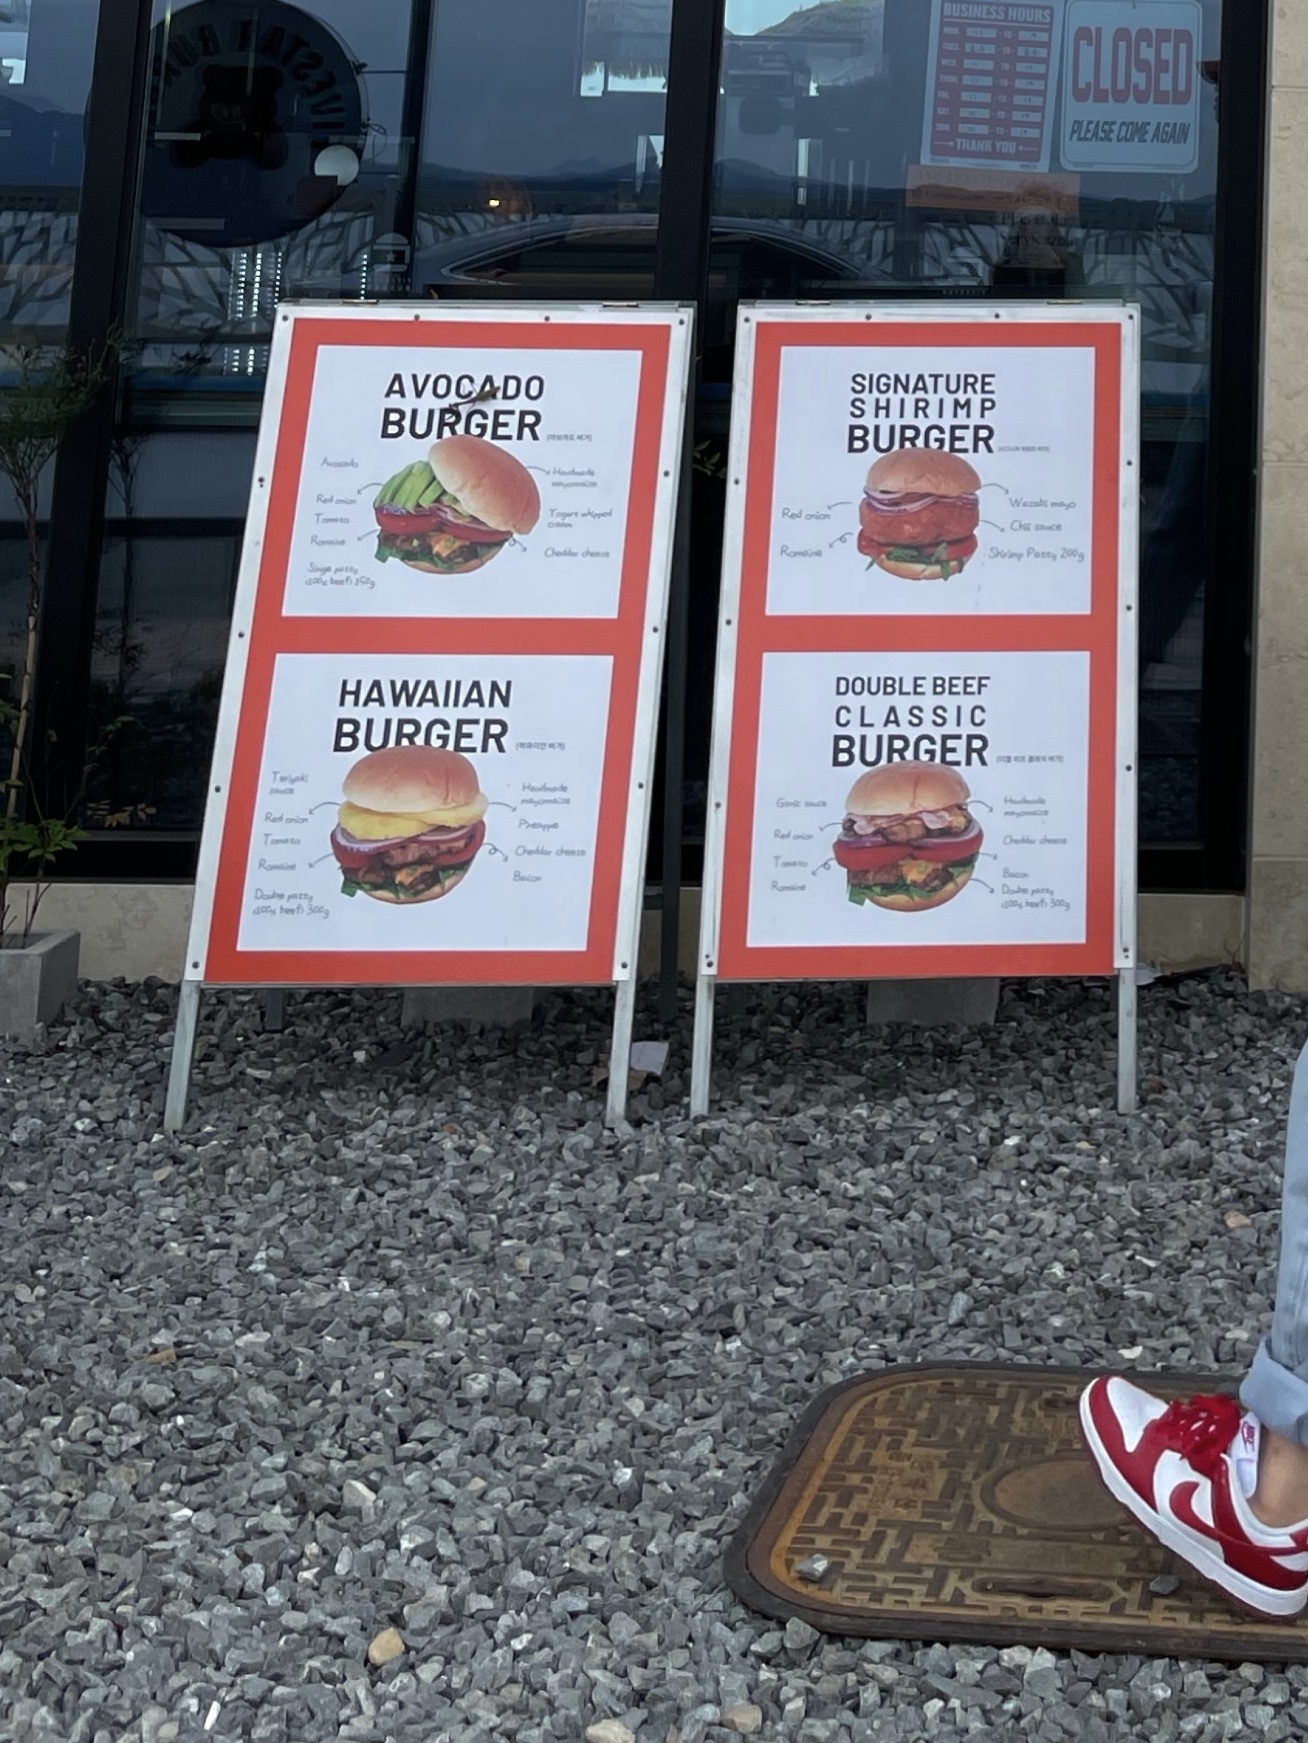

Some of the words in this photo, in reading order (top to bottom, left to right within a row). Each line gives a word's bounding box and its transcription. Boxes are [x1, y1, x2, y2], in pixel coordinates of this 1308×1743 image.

[943, 2, 1005, 20] BUSINESS
[1007, 6, 1051, 23] HOURS
[1072, 25, 1193, 105] CLOSED
[1069, 119, 1117, 142] PLEASE
[1117, 121, 1151, 143] COME
[1150, 122, 1192, 144] AGAIN
[955, 138, 992, 153] THANK
[994, 139, 1017, 154] YOU
[384, 373, 545, 401] AVOCADO
[850, 373, 996, 394] SIGNATURE
[849, 398, 997, 419] SHIRIMP
[380, 407, 542, 441] BURGER
[847, 424, 995, 454] BURGER
[321, 456, 359, 469] Avocado
[316, 493, 334, 505] Red
[335, 497, 357, 505] onion
[314, 512, 350, 525] Tomato
[549, 508, 579, 521] Yogurt
[782, 507, 802, 519] Red
[804, 511, 831, 520] onion
[780, 544, 823, 558] Romaine
[339, 680, 513, 708] HAWAIIAN
[835, 676, 926, 696] DOUBLE
[932, 676, 991, 696] BEEF
[835, 705, 987, 728] CLASSIC
[333, 718, 509, 754] BURGER
[832, 733, 989, 767] BURGER
[264, 812, 283, 824] Red
[284, 815, 309, 824] onion
[263, 833, 301, 846] Tomato
[774, 829, 791, 839] Red
[515, 845, 552, 857] Cheddar
[258, 858, 297, 871] Romaine
